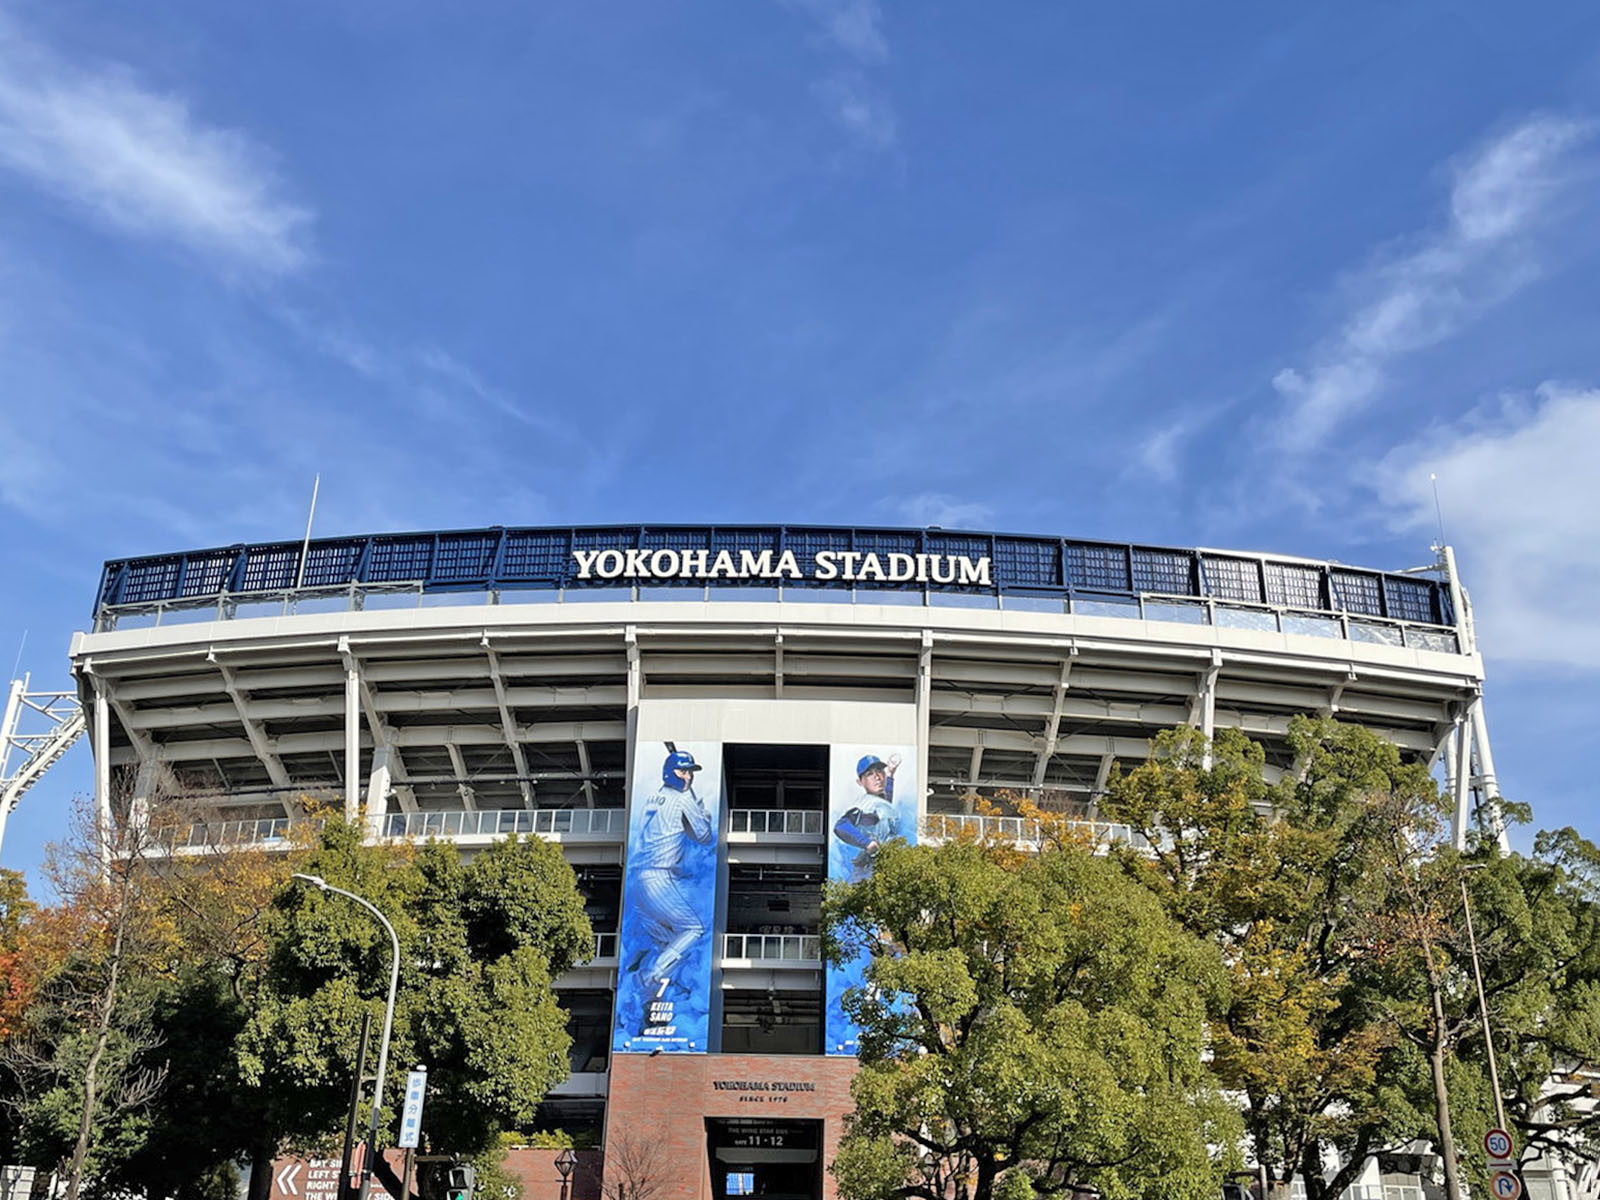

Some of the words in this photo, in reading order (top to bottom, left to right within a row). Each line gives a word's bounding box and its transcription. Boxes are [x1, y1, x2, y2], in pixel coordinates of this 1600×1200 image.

[573, 549, 803, 579] YOKOHAMA
[814, 550, 992, 586] STADIUM
[656, 978, 670, 998] 7
[650, 1002, 674, 1012] KEITA
[649, 1012, 674, 1022] SANO
[713, 1081, 770, 1091] YOKOHAMA
[771, 1082, 815, 1092] STADIUM
[1490, 1137, 1507, 1151] 50
[309, 1159, 327, 1168] BAY
[308, 1170, 329, 1179] LEFT
[306, 1181, 335, 1190] RIGHT
[305, 1192, 323, 1200] THE
